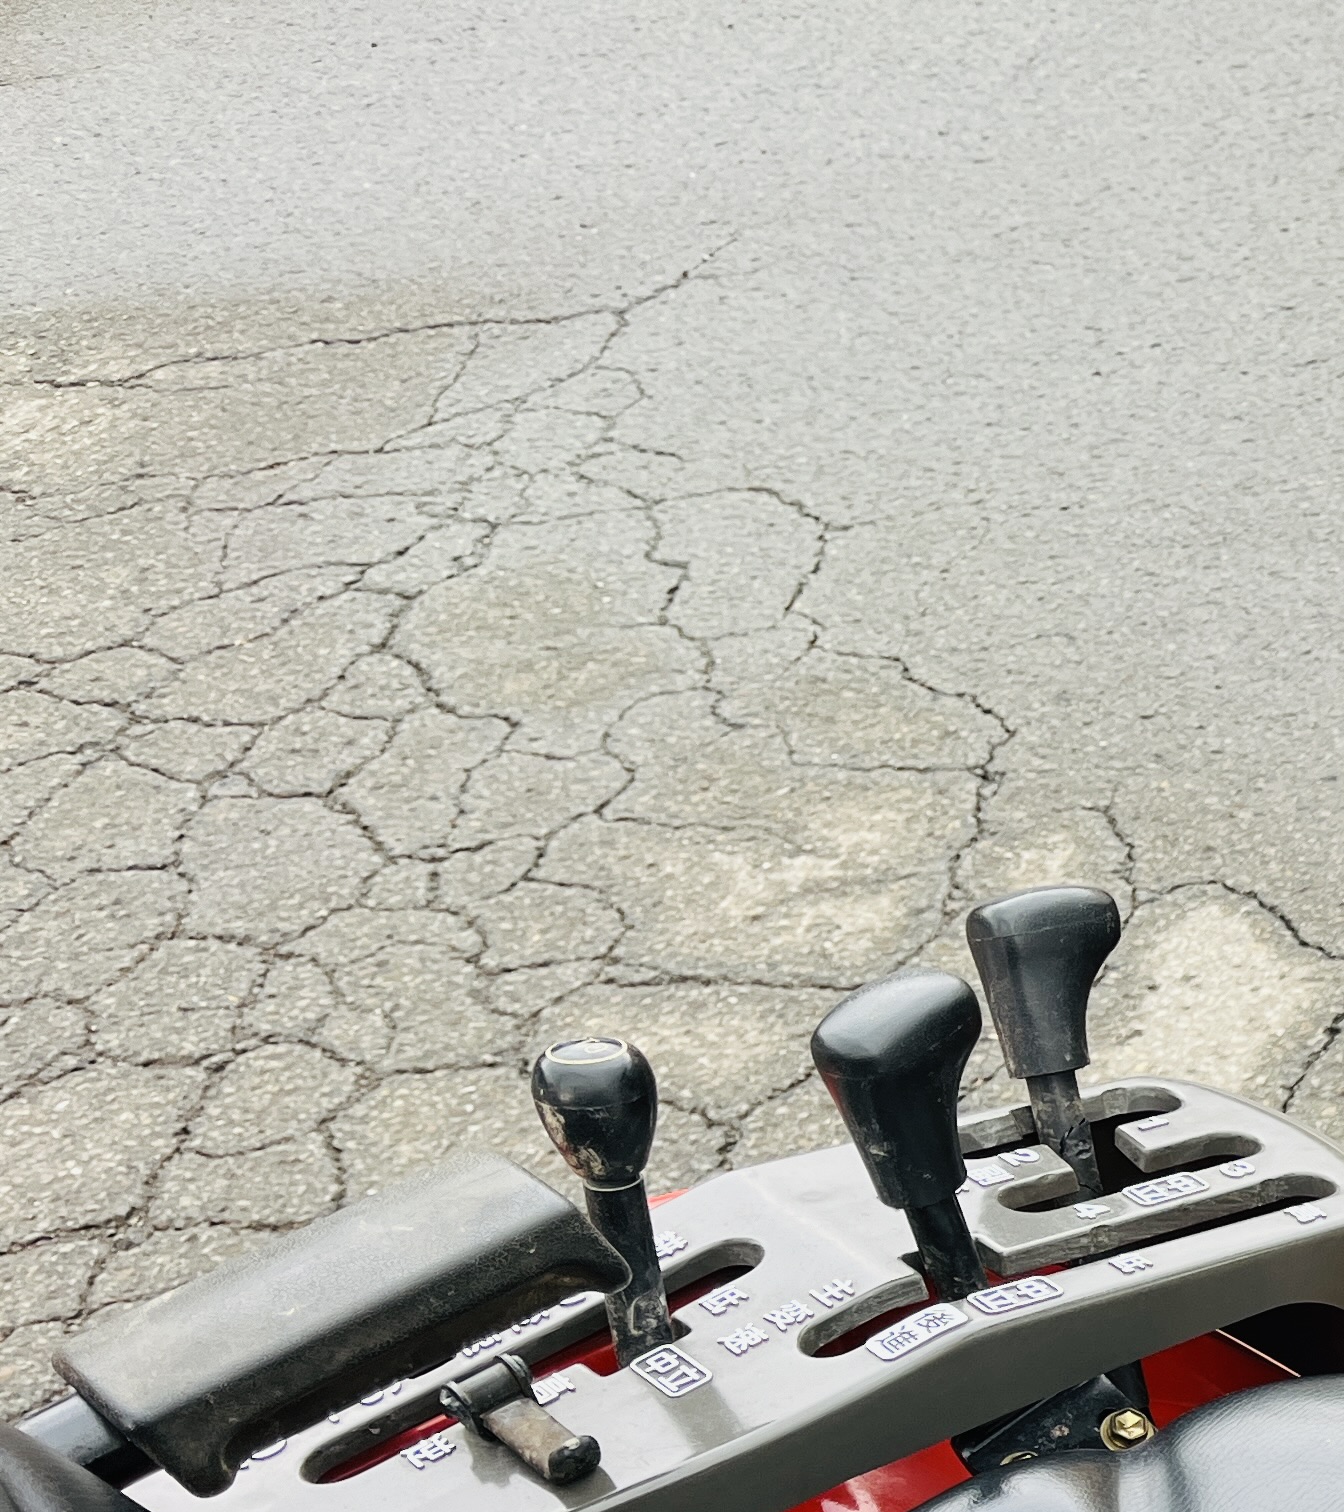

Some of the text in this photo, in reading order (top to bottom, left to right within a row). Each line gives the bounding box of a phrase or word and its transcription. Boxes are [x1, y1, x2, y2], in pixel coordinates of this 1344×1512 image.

[1136, 1116, 1171, 1131] 1
[997, 1147, 1041, 1167] 2
[1219, 1160, 1257, 1179] 3
[1130, 1173, 1199, 1203] 中立
[1073, 1200, 1111, 1220] 4
[1283, 1201, 1328, 1224] 高
[1107, 1252, 1154, 1275] 低
[697, 1284, 750, 1317] 低
[974, 1280, 1050, 1312] 中立
[716, 1278, 856, 1357] 主変速
[877, 1308, 956, 1356] 後進
[644, 1350, 702, 1392] 中立
[531, 1371, 577, 1406] 高
[401, 1431, 458, 1470] 逆
